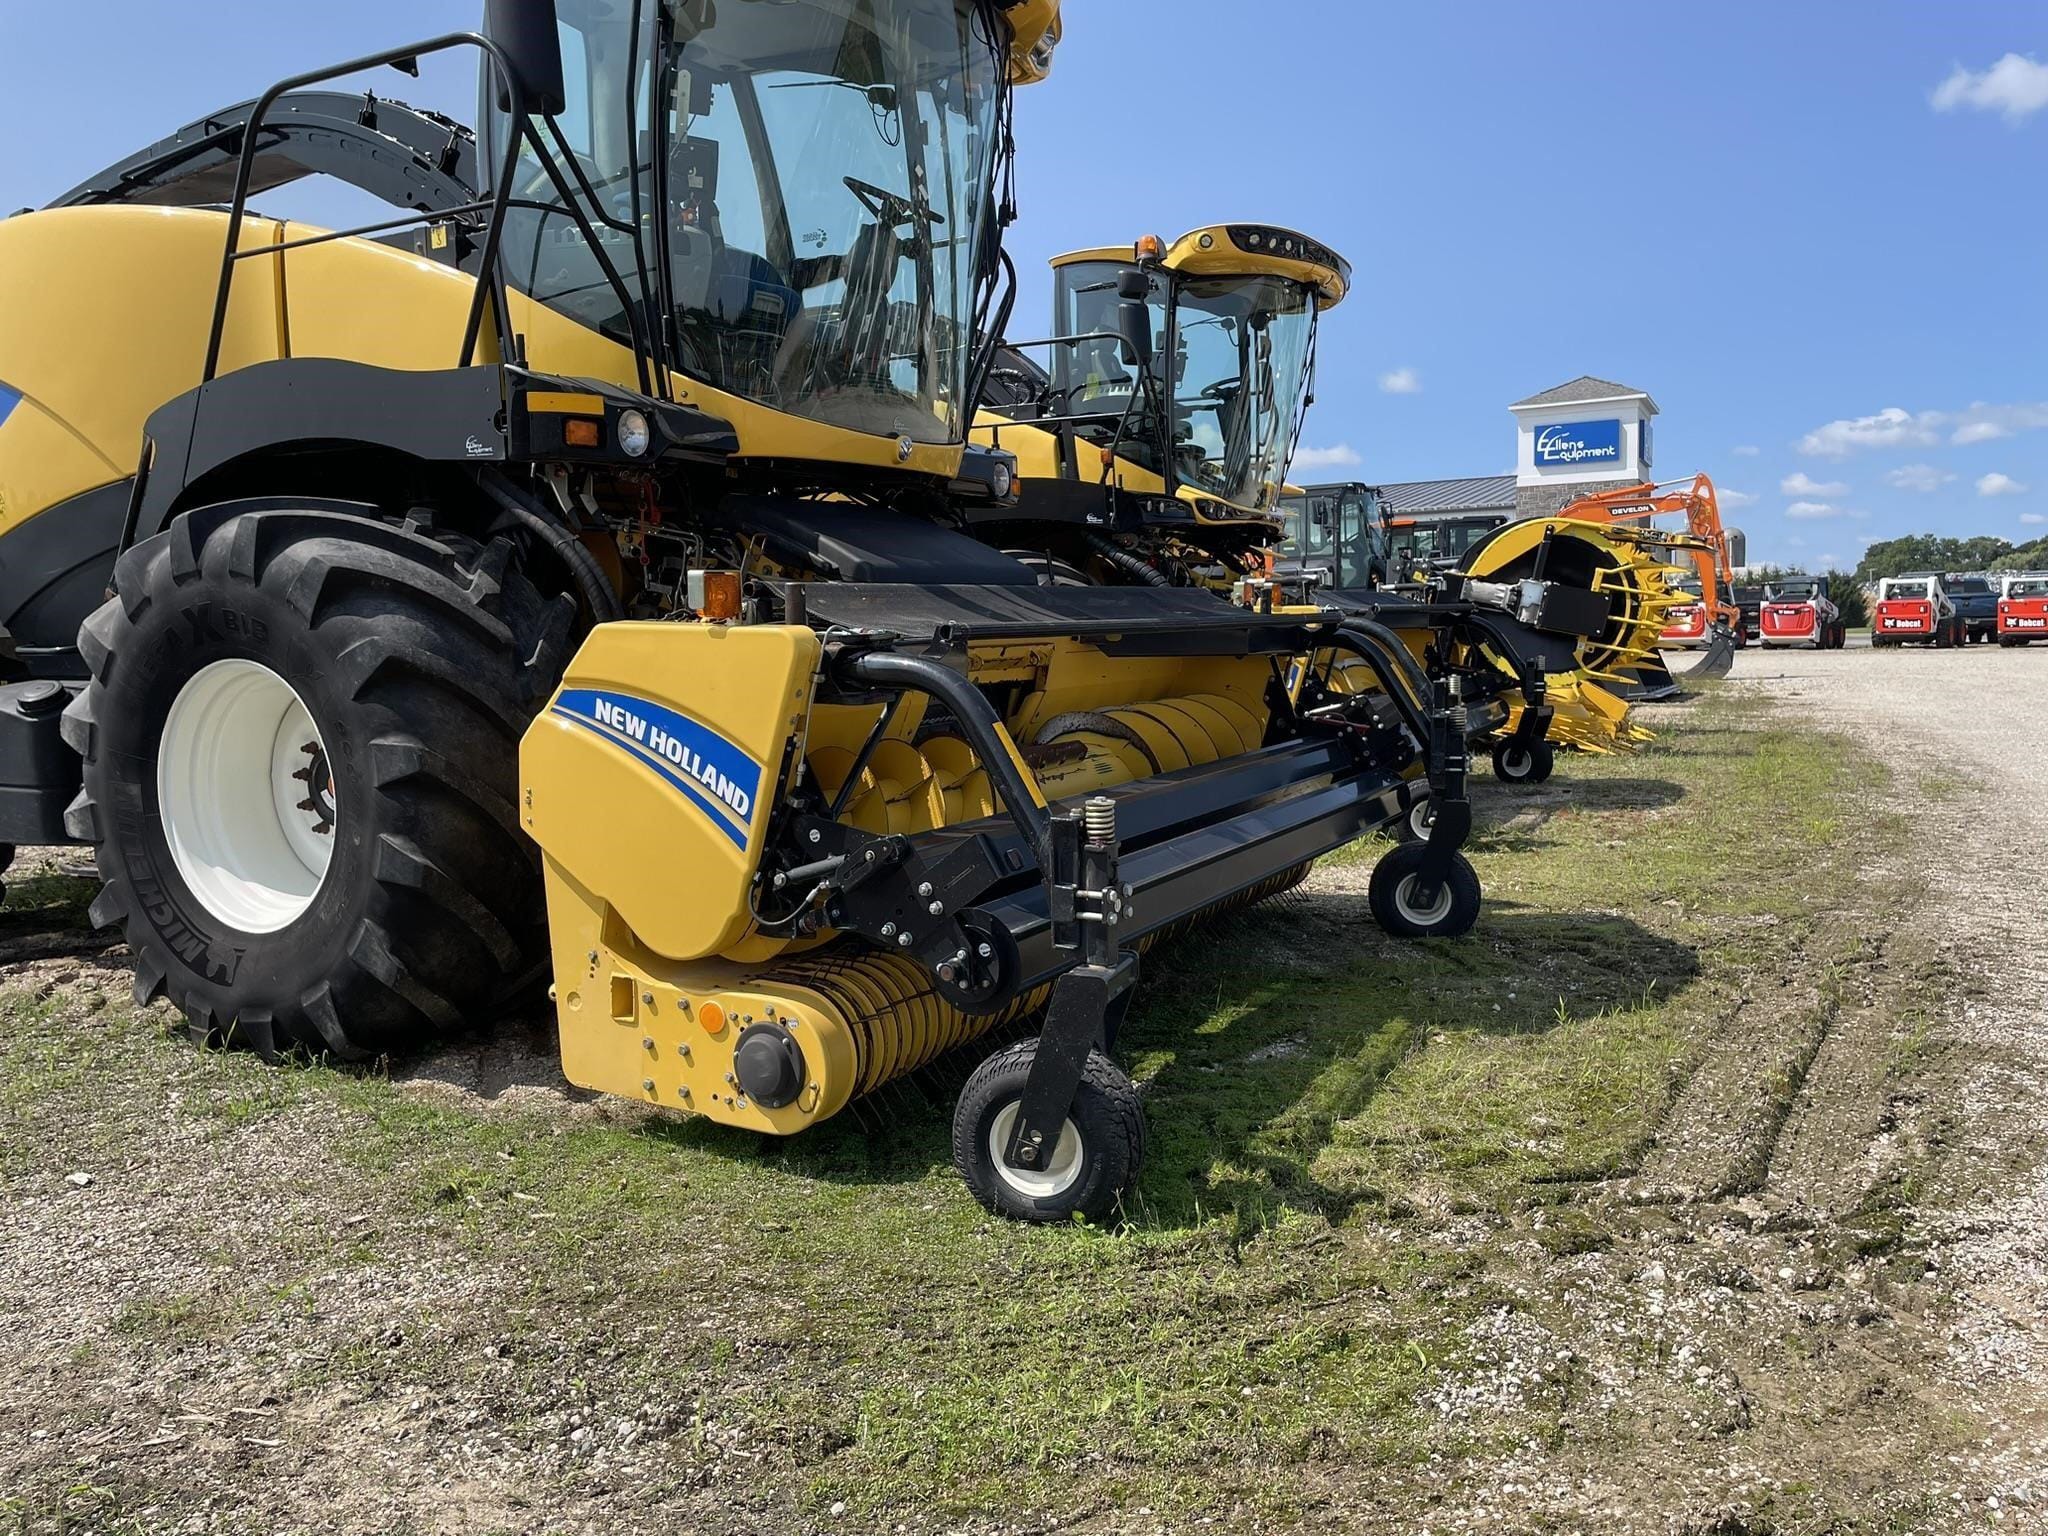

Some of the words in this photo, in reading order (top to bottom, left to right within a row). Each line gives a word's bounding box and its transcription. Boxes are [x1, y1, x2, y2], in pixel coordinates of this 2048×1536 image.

[1537, 426, 1584, 451] Ellens
[1544, 432, 1615, 462] Equipment
[1611, 505, 1649, 515] DEVELON
[1896, 619, 1922, 628] Bobcat
[2018, 618, 2045, 627] Bobcat
[594, 697, 647, 741] NEW
[649, 725, 750, 816] HOLLAND
